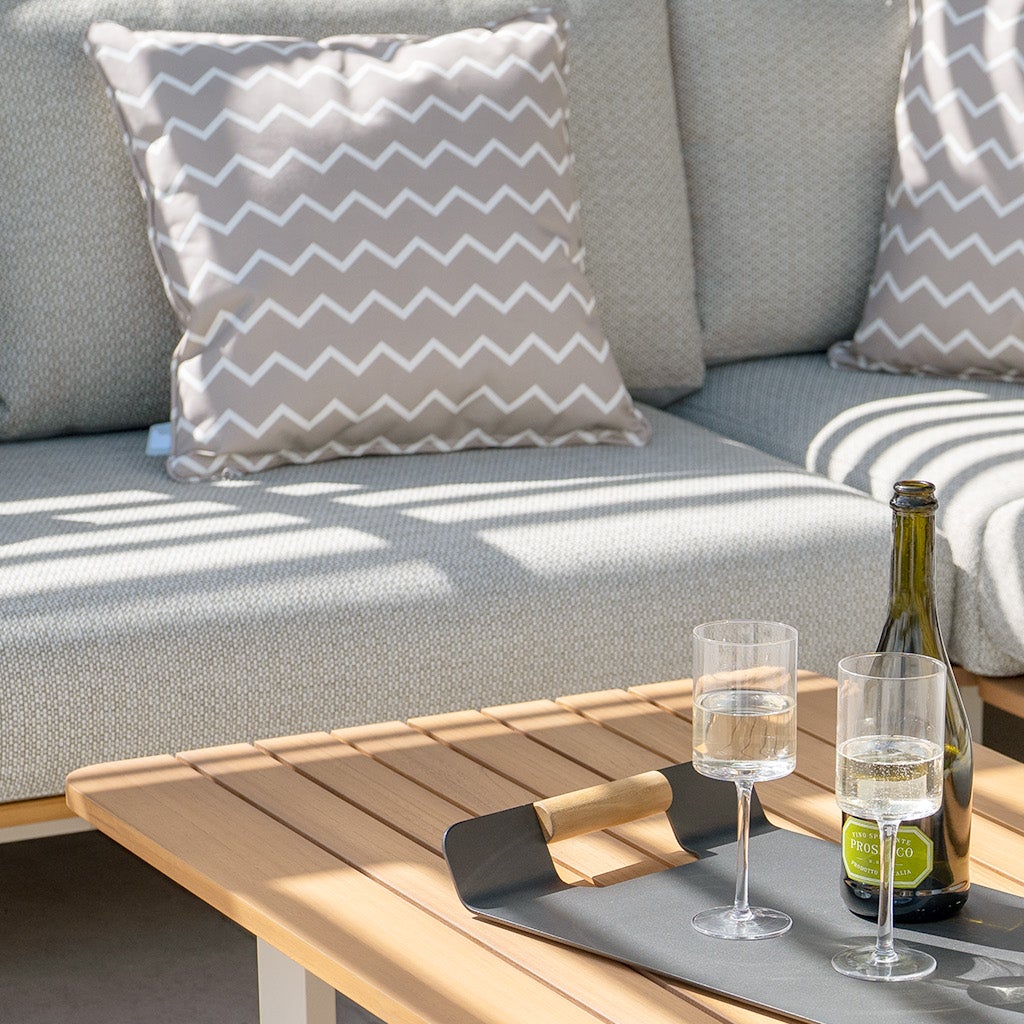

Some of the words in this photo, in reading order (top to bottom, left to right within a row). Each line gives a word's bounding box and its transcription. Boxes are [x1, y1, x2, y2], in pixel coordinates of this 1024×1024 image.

[870, 833, 911, 846] SPNTE
[851, 838, 914, 858] PROSCO
[851, 860, 879, 876] PRODOTTO
